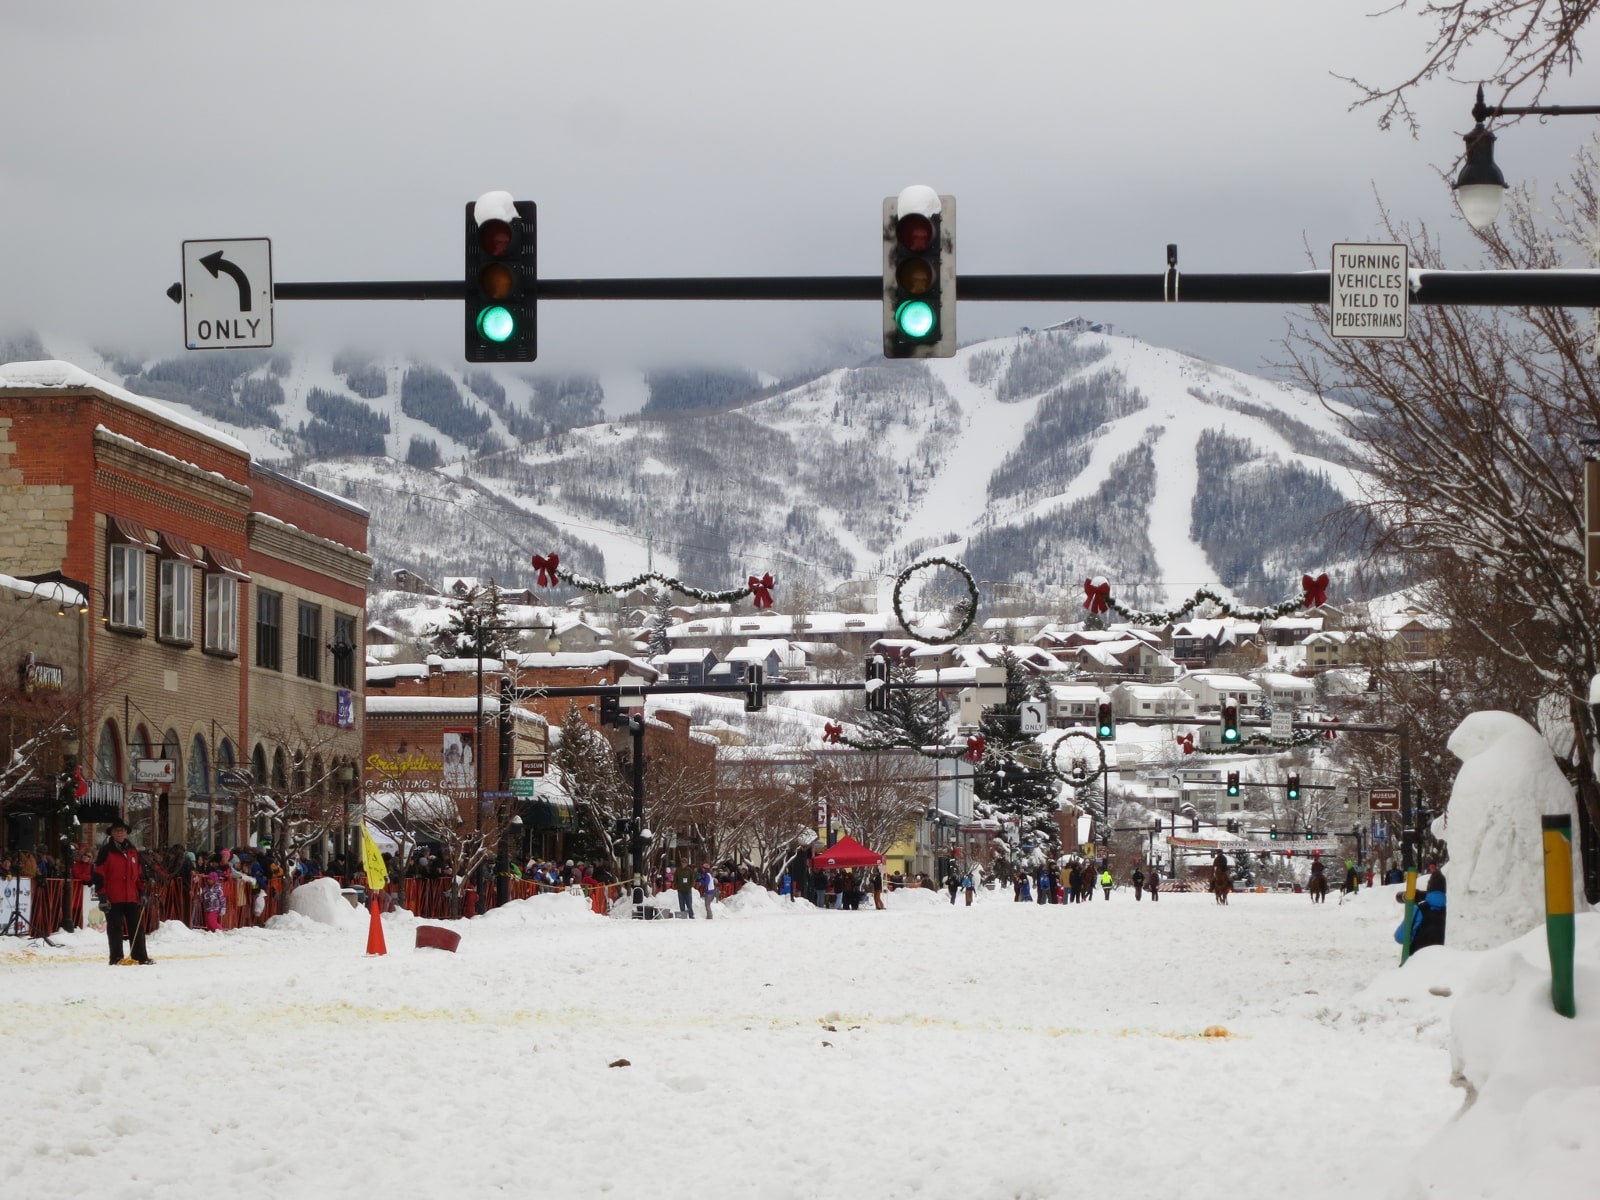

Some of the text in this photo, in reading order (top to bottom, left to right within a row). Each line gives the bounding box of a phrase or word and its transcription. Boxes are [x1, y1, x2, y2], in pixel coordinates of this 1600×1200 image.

[1340, 254, 1400, 269] TURNING
[1337, 273, 1402, 289] VEHICLES
[1340, 293, 1399, 308] YIELD TO
[1336, 312, 1402, 328] PEDESTRIANS
[198, 318, 260, 340] ONLY
[35, 665, 62, 689] CANTINA
